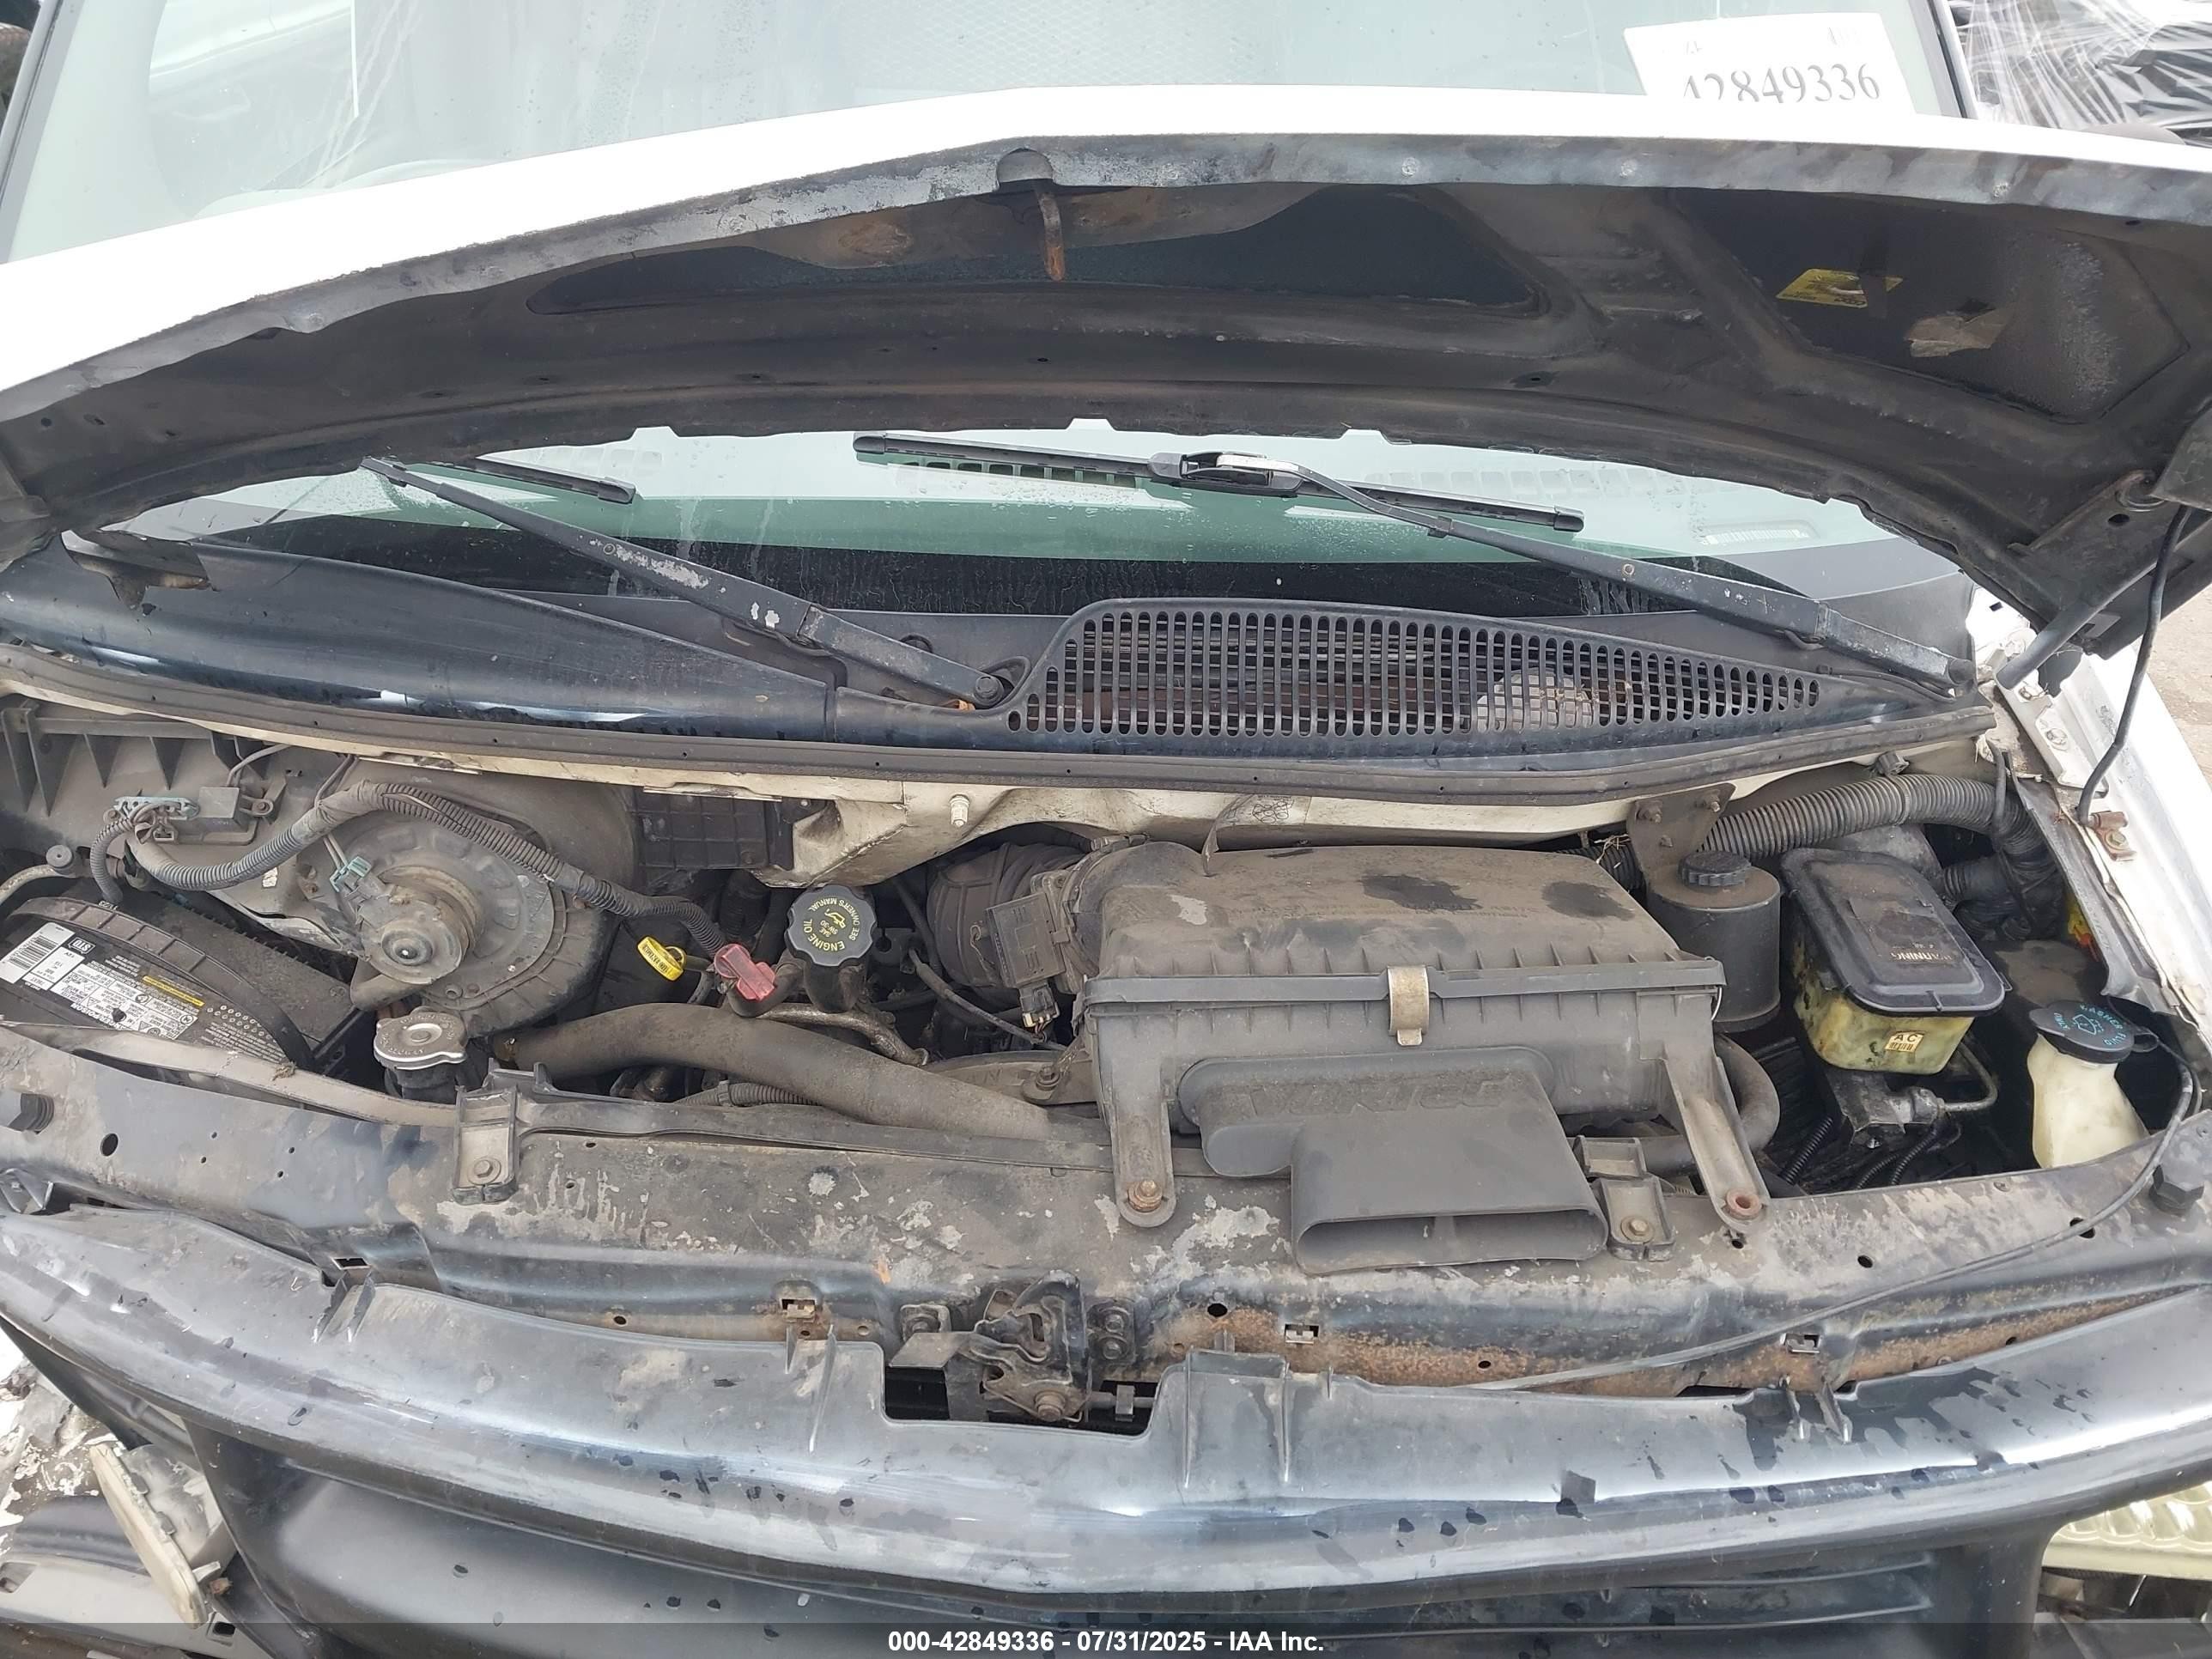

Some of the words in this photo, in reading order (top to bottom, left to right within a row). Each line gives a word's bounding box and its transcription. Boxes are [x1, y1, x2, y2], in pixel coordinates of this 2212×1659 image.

[807, 897, 837, 912] MANUAL
[838, 899, 860, 926] OWNER'S
[803, 918, 812, 933] OIL
[819, 927, 831, 938] SAE
[820, 920, 838, 935] 5W-30
[848, 927, 860, 941] SEE
[807, 933, 845, 951] ENGINE
[2080, 1004, 2124, 1030] WASHER
[2104, 1032, 2126, 1046] FLUID
